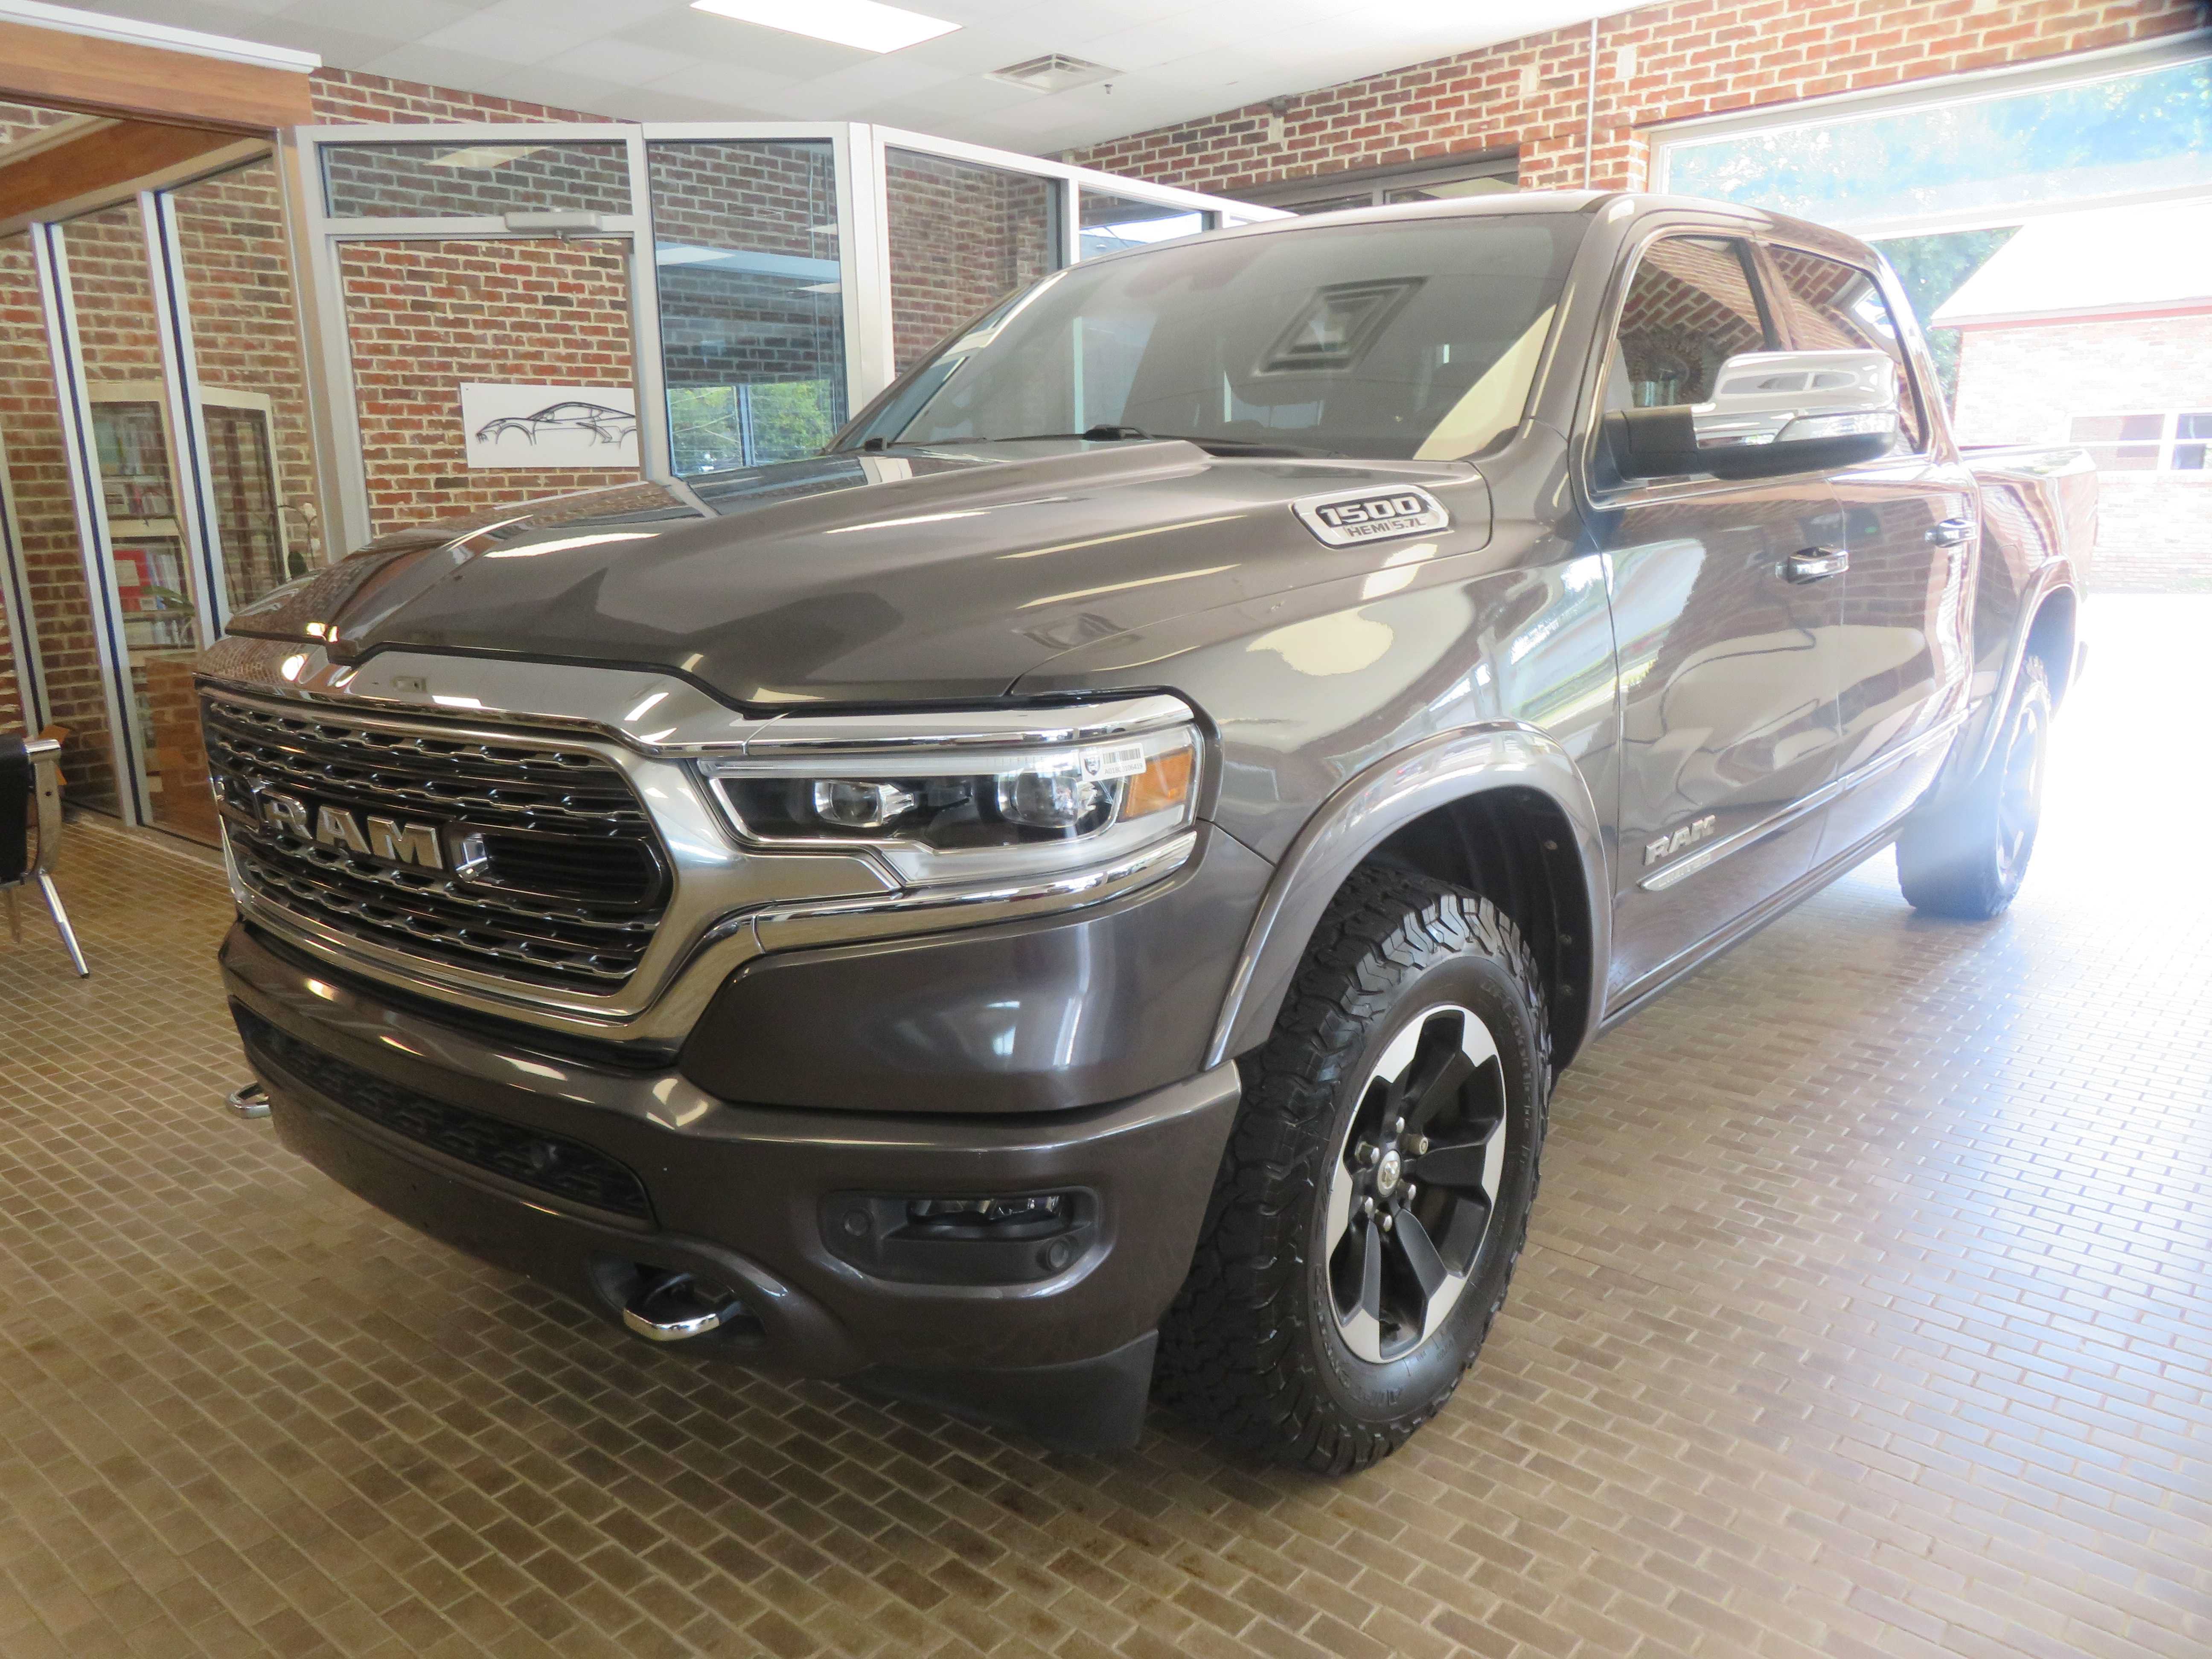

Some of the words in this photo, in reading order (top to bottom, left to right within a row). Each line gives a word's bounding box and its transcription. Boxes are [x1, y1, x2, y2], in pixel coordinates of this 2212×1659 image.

[1320, 496, 1422, 526] 1500
[1346, 521, 1391, 538] HEMI
[1391, 518, 1426, 530] 5.7L
[260, 789, 443, 869] RAM
[1644, 814, 1716, 866] RAM
